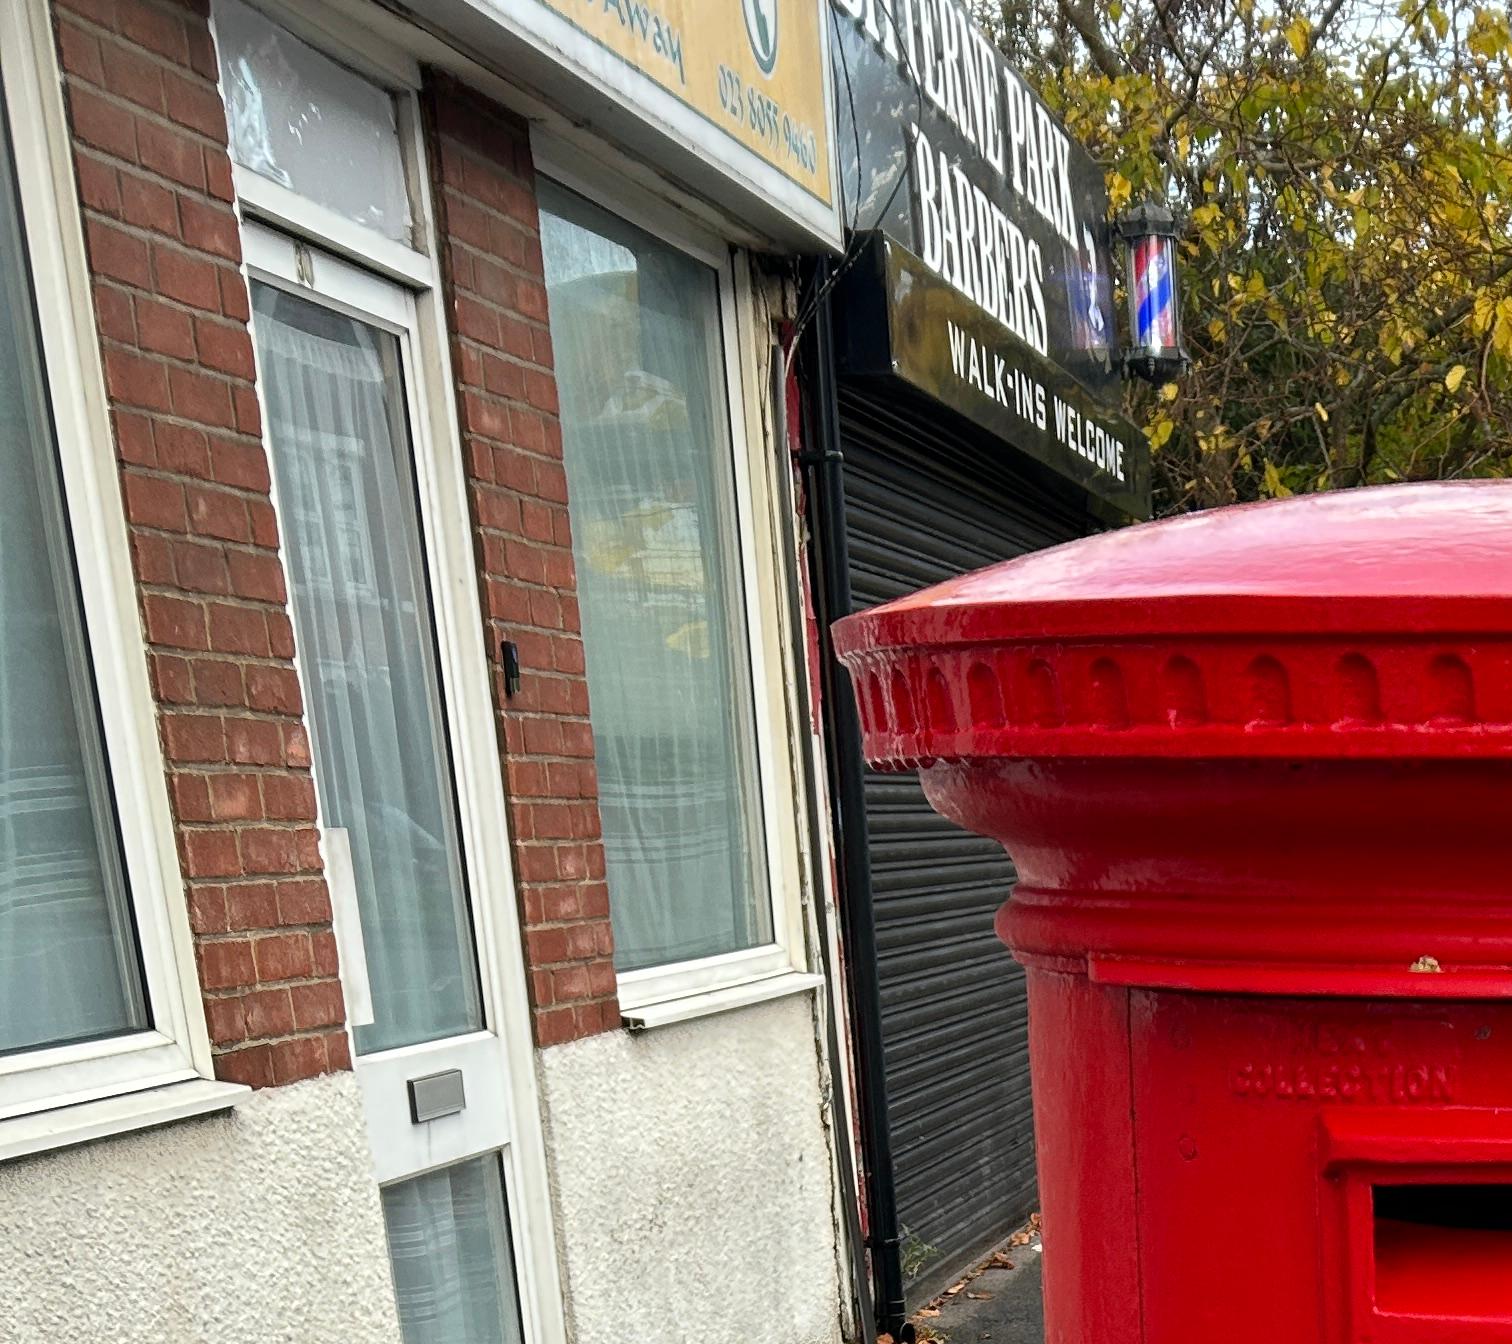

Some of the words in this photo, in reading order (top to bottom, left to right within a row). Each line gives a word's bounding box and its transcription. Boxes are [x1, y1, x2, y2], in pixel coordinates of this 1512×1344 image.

[718, 64, 744, 122] 023
[1003, 66, 1079, 250] PARK
[912, 121, 1048, 358] BARBERS
[947, 320, 1047, 431] WALK-INS
[1053, 395, 1125, 482] WELCOME
